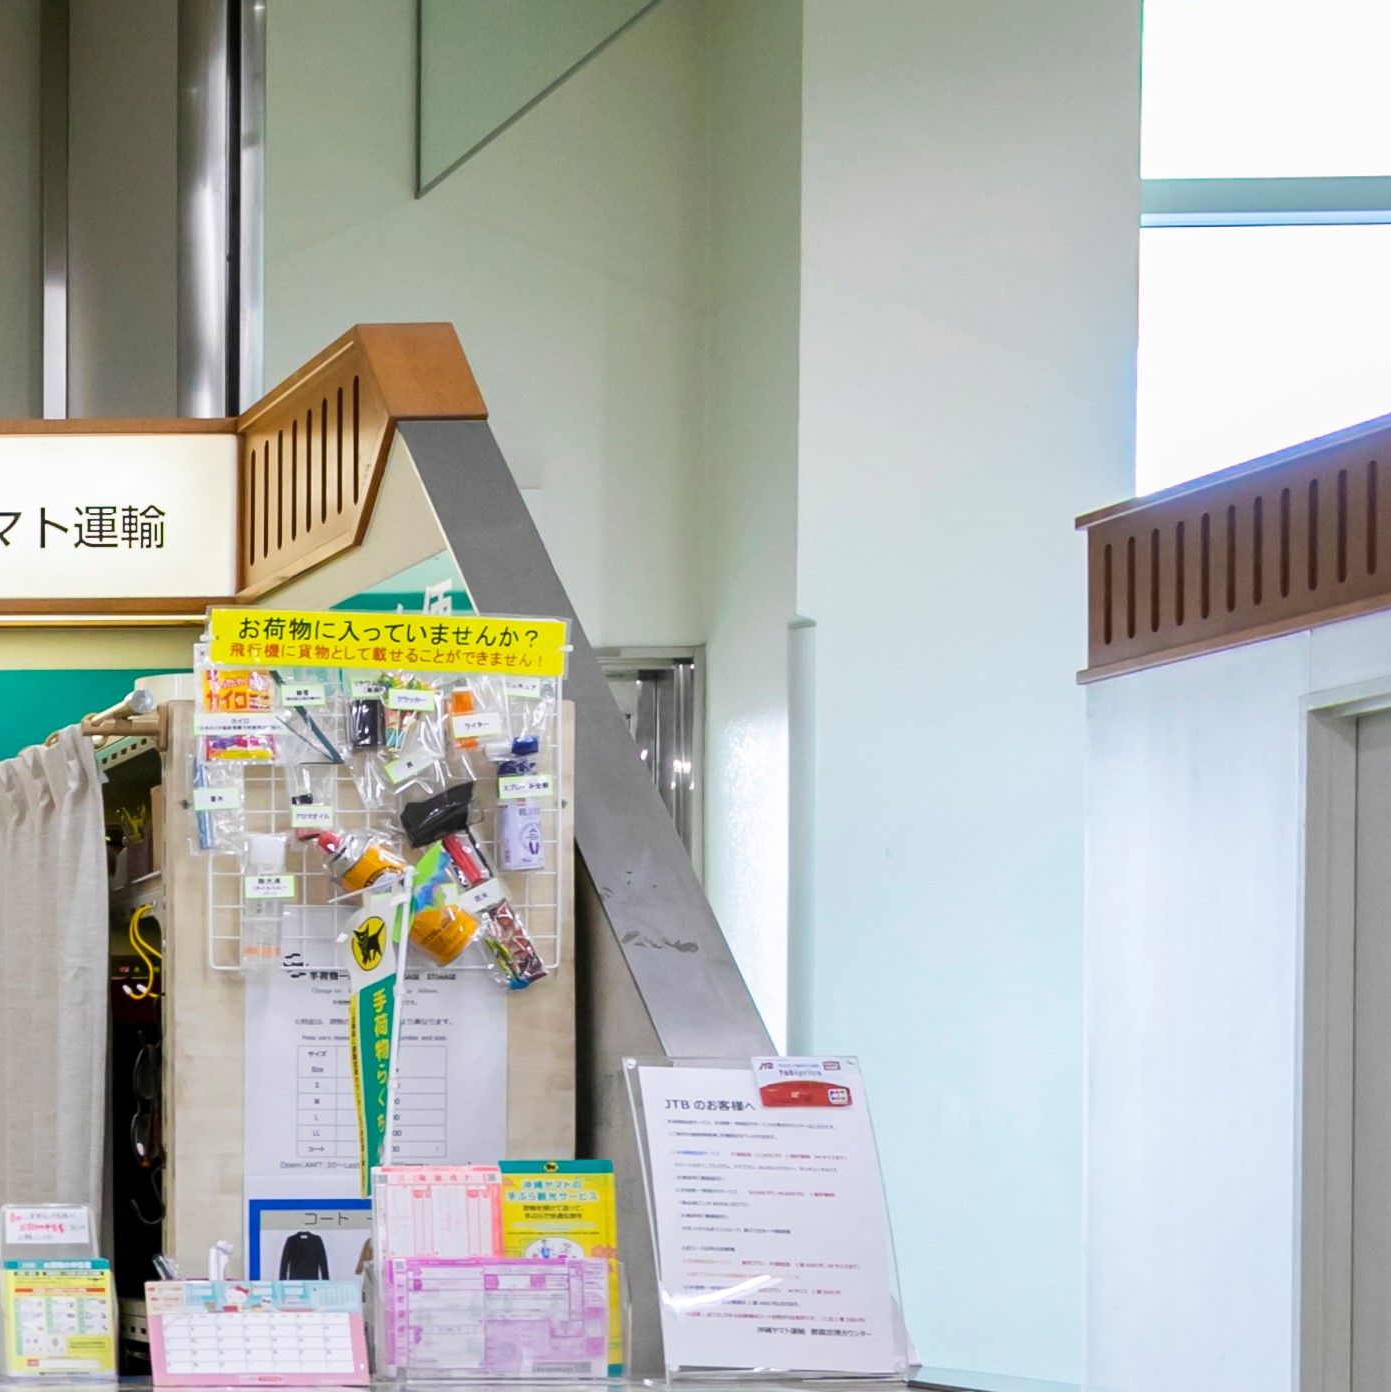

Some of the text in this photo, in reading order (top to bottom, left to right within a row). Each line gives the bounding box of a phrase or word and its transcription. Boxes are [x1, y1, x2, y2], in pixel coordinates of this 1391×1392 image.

[665, 1099, 757, 1112] JTB のお客様へ
[303, 1211, 349, 1226] コート
